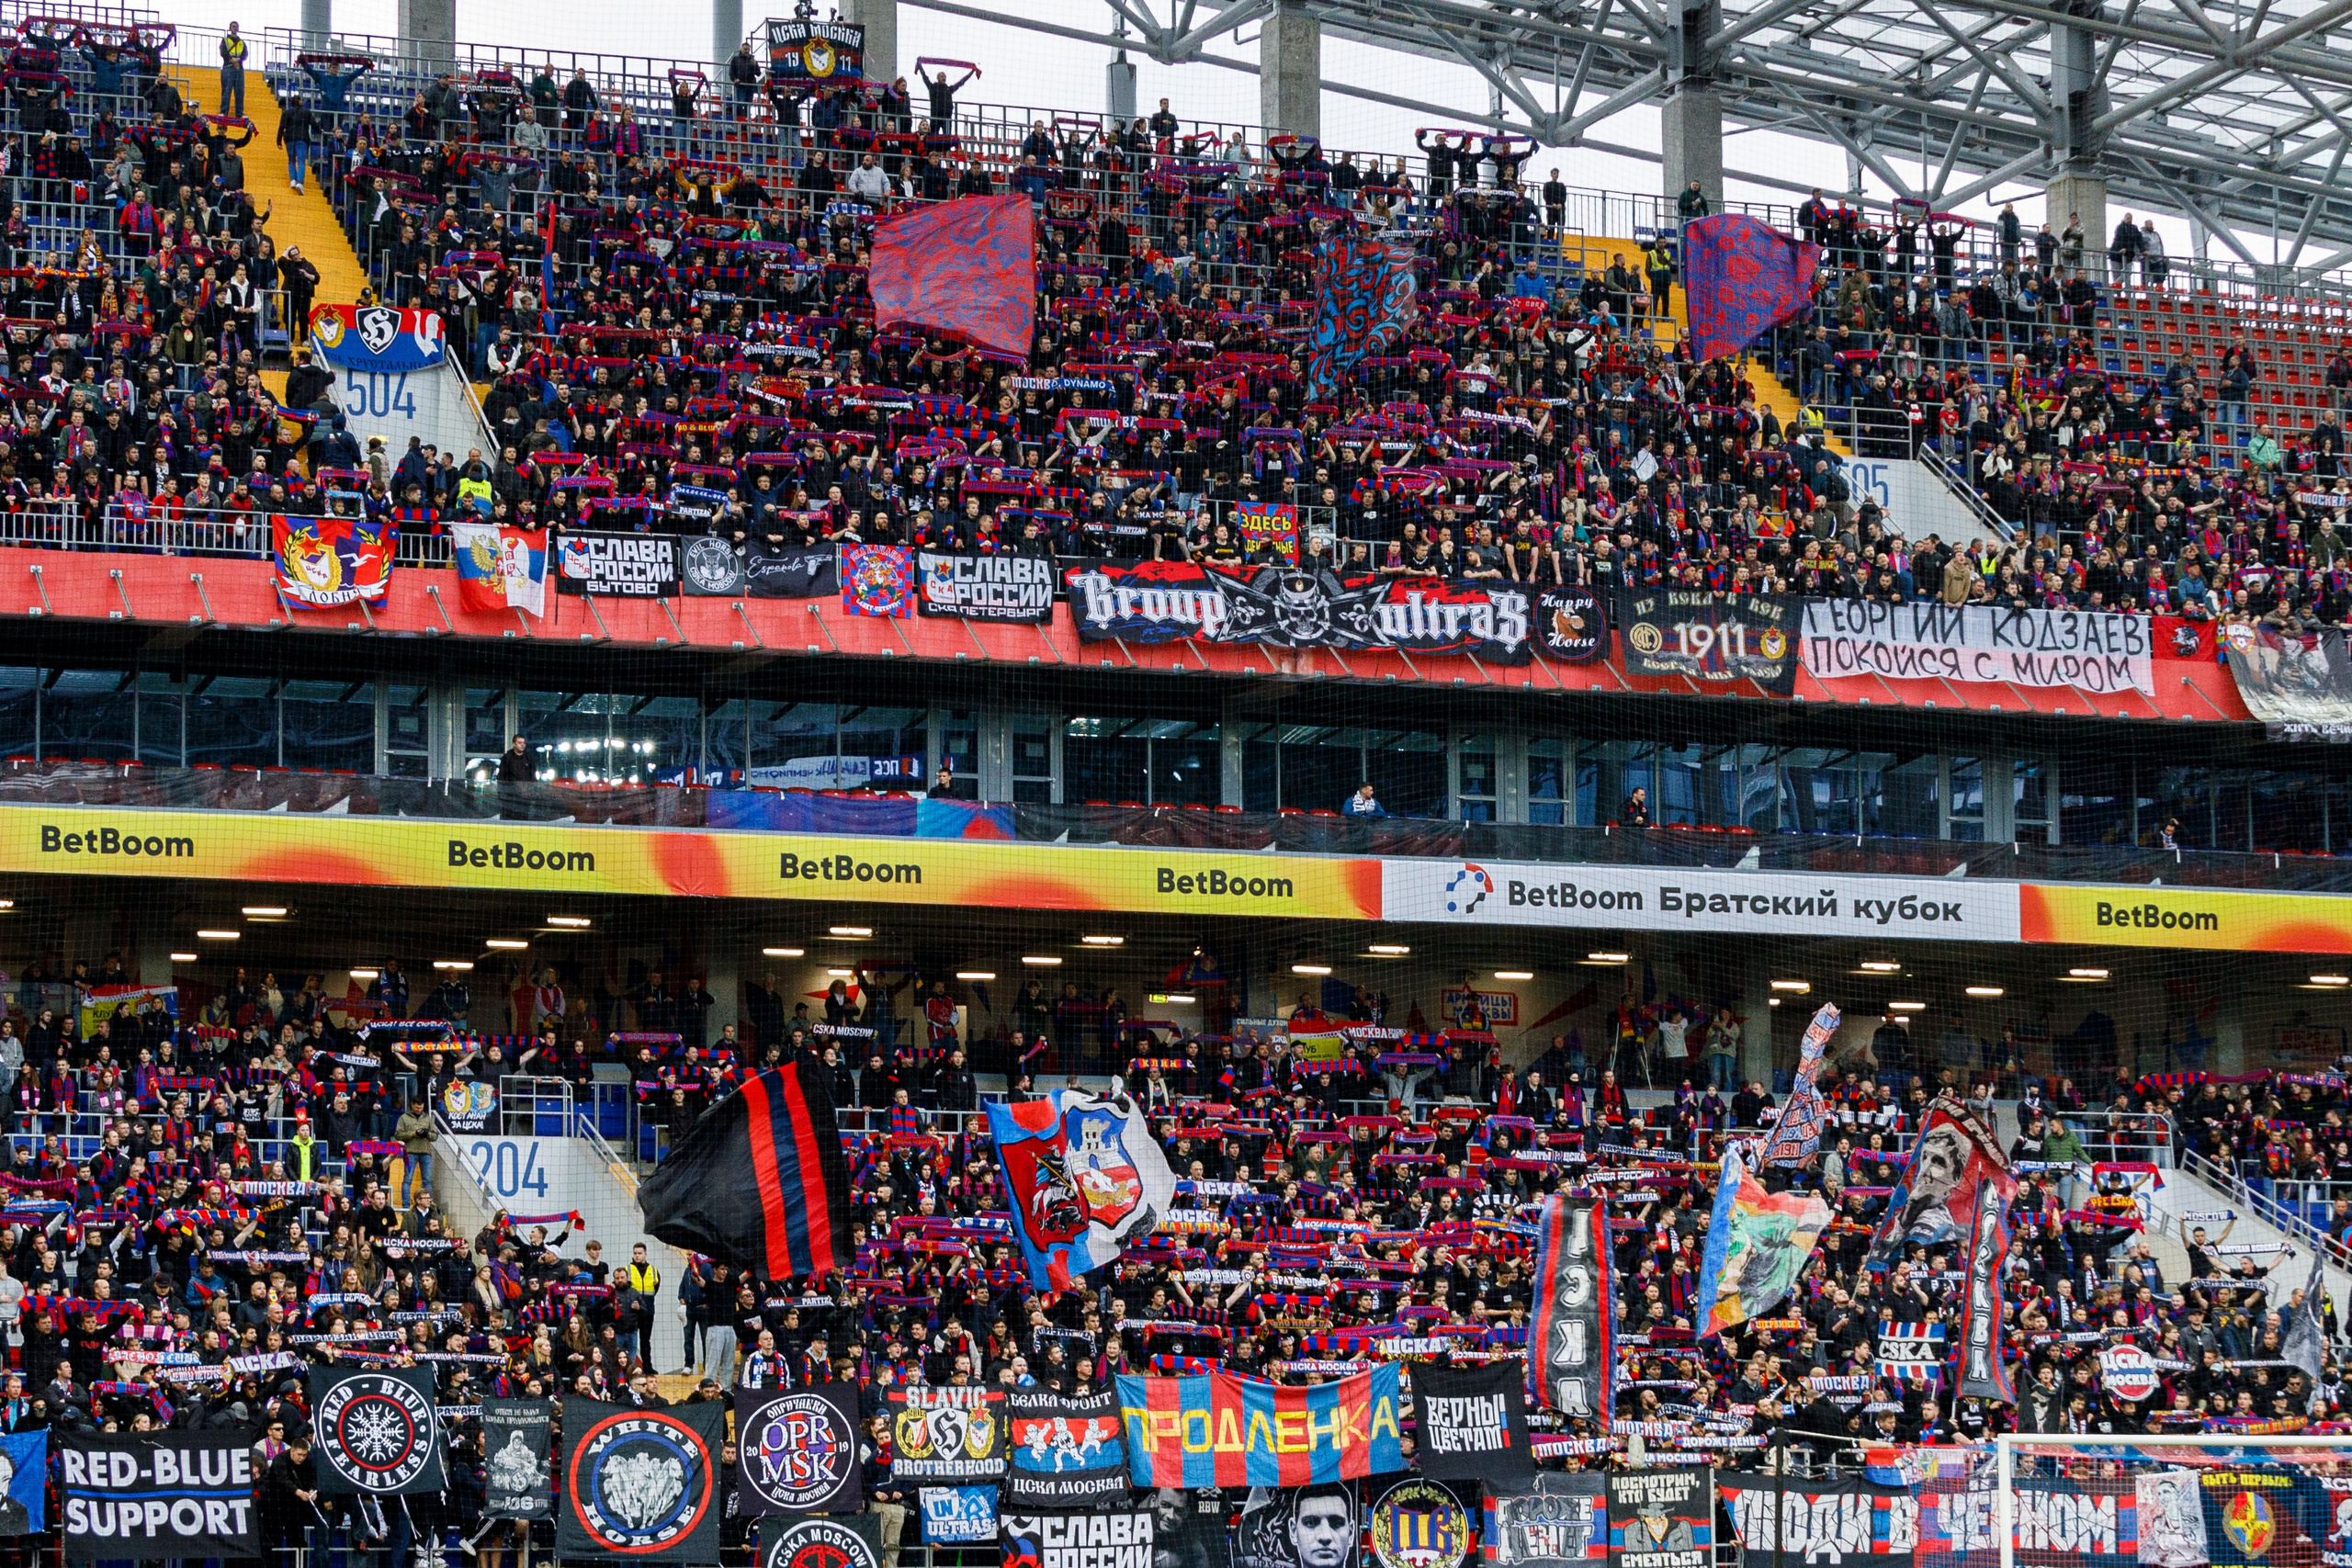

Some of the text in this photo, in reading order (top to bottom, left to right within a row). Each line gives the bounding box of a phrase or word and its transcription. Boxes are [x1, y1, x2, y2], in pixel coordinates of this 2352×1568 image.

[772, 23, 862, 48] ЦСКА МОСКВА
[786, 51, 852, 72] 19 11
[346, 367, 416, 419] 504
[1063, 378, 1106, 389] DYNAMO
[2303, 493, 2346, 507] МОСКВА
[1240, 513, 1292, 532] ЗДЕСЬ
[588, 538, 673, 563] СЛАВА
[690, 540, 733, 559] EVIL HORSE
[591, 561, 674, 582] РОССИИ
[689, 567, 736, 590] CSKA MOSCOW
[955, 557, 1050, 582] СЛАВА
[587, 581, 659, 594] БУТОВО
[956, 582, 1052, 606] РОССИИ
[961, 604, 1046, 617] ПЕТЕРБУРГ
[1540, 593, 1593, 612] Happy
[1804, 598, 2143, 656] ГЕОРГИЙ КОДЗАЕВ
[1546, 632, 1597, 649] Horse
[1673, 622, 1747, 658] 1911
[1811, 637, 2131, 694] ПОКОЙСЯ С МИРОМ
[41, 825, 194, 857] BetBoom
[448, 840, 595, 872] BetBoom
[780, 853, 922, 885] BetBoom
[1157, 868, 1294, 897] BetBoom
[1508, 880, 1963, 926] BetBoom Братский кубок
[2097, 902, 2219, 931] BetBoom
[813, 1025, 874, 1038] CSKA MOSCOW
[1348, 1028, 1387, 1039] МОСКВА
[343, 1055, 379, 1066] PARTIZAN
[1141, 1058, 1179, 1068] КЛИН
[471, 1141, 548, 1197] 204
[244, 1181, 306, 1195] МОСКВА
[2090, 1198, 2109, 1207] PFC
[2185, 1211, 2229, 1221] MOSCOW
[1180, 1221, 1227, 1234] ULTRAS
[383, 1238, 453, 1248] ЦСКА МОСКВА
[1909, 1270, 1928, 1279] CSKA
[1757, 1320, 1802, 1329] ЩЕРБИНКА
[1385, 1337, 1441, 1354] ЦСКА
[1878, 1340, 1934, 1361] CSKA
[231, 1353, 290, 1372] ЦСКА
[1290, 1362, 1358, 1371] ЦСКА МОСКВА
[2102, 1351, 2156, 1370] ЦСКА
[1812, 1375, 1870, 1390] МОСКВА
[2105, 1373, 2158, 1387] МОСКВА
[323, 1385, 354, 1423] RED
[379, 1379, 427, 1422] BLUE
[906, 1385, 987, 1409] SLAVIC
[1011, 1393, 1058, 1407] БЕЛКА
[1425, 1393, 1505, 1427] ВЕРНЫ
[762, 1416, 833, 1451] OPR
[1121, 1396, 1398, 1454] ПРОДЛЕНКА
[1613, 1419, 1674, 1437] МОСКВА
[588, 1421, 698, 1459] WHITE
[839, 1442, 849, 1452] 19
[1429, 1425, 1503, 1454] ЦВЕТАМ
[1538, 1438, 1608, 1458] МОСКВА
[1682, 1436, 1760, 1448] ДОРОЖЕ ДЕНЕГ
[746, 1446, 758, 1457] 20
[1657, 1452, 1701, 1463] МОСКВА
[62, 1448, 251, 1487] RED-BLUE
[327, 1438, 428, 1487] FEARLESS
[760, 1450, 839, 1484] MSK
[894, 1457, 1005, 1476] BROTHERHOOD
[1013, 1476, 1124, 1495] ЦСКА МОСКВА
[1612, 1473, 1701, 1491] ПОСМОТРИМ,
[2202, 1472, 2237, 1487] БЫТЬ
[1618, 1486, 1690, 1503] КТО БУДЕТ
[1197, 1500, 1220, 1514] RBW
[1496, 1496, 1592, 1524] ДОРОЖЕ
[67, 1498, 252, 1537] SUPPORT
[582, 1502, 696, 1547] HORSE
[927, 1517, 995, 1536] ULTRAS
[1891, 1495, 1918, 1553] В
[1042, 1513, 1154, 1548] СЛАВА
[777, 1528, 867, 1567] CSKA MOSCOW
[1043, 1545, 1154, 1568] РОССИИ
[1621, 1552, 1703, 1565] СМЕЯТЬСЯ
